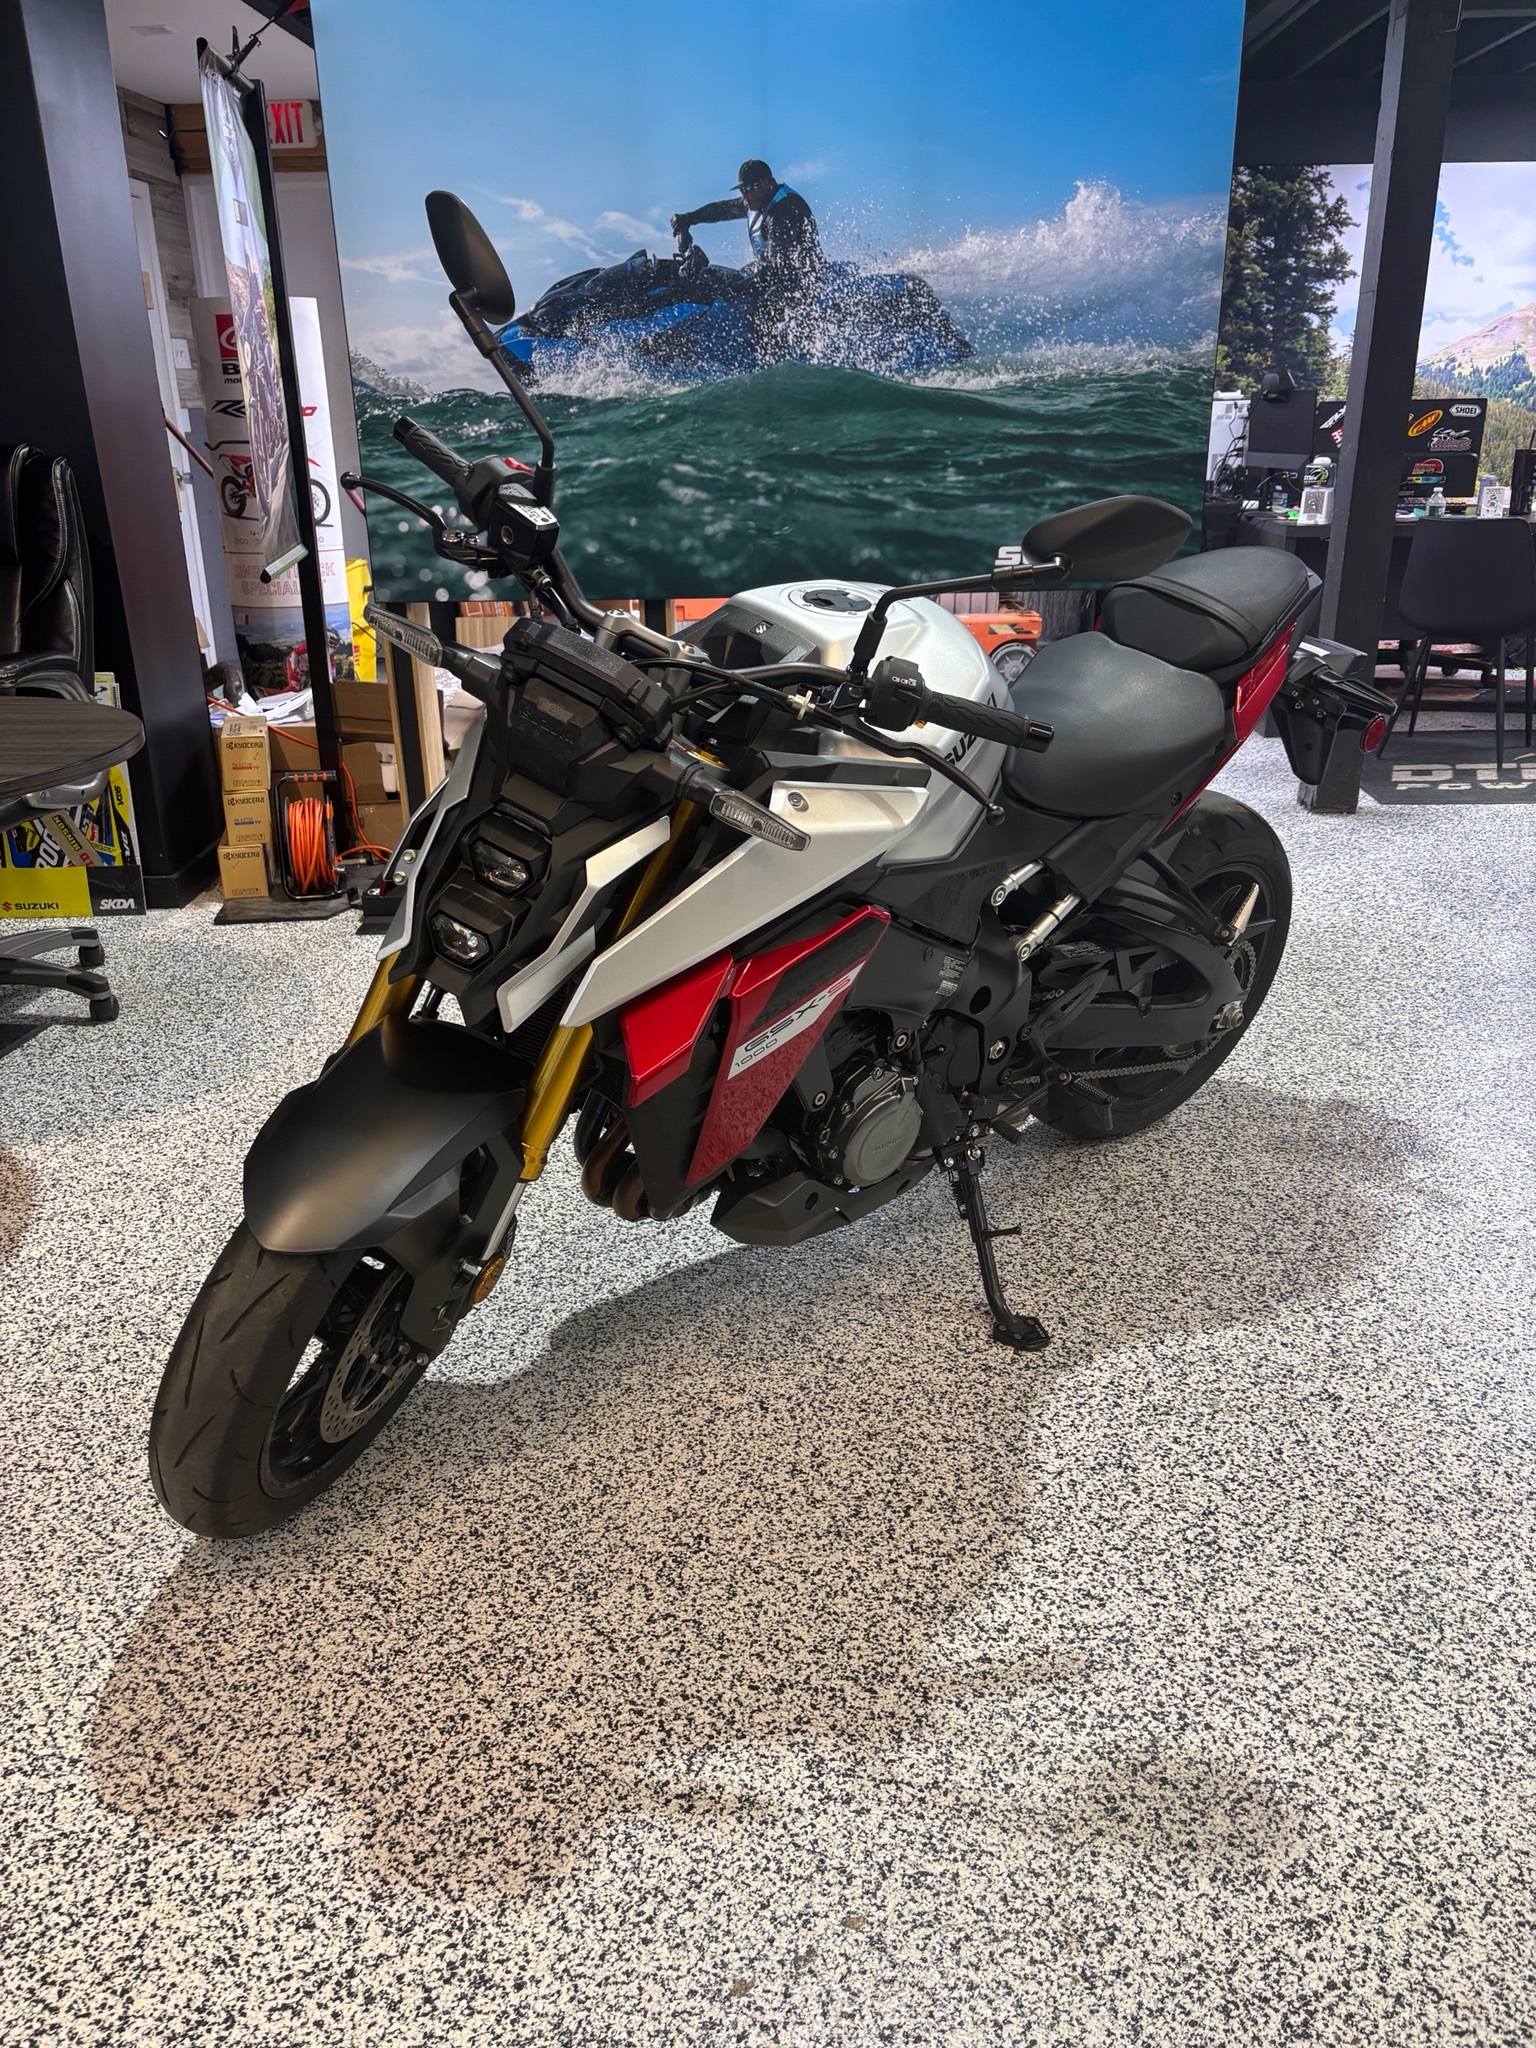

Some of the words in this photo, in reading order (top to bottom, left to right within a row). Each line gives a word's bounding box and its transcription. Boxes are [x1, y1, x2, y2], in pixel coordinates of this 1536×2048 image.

[1454, 406, 1477, 414] SHOEI
[995, 545, 1032, 566] S
[1391, 763, 1536, 782] DT
[235, 797, 265, 805] KYOCERA
[231, 851, 260, 859] KYOCERA
[14, 902, 59, 911] SUZUKI
[99, 898, 136, 911] SKDA
[744, 976, 851, 1053] GSX-S
[735, 1038, 778, 1067] 1000
